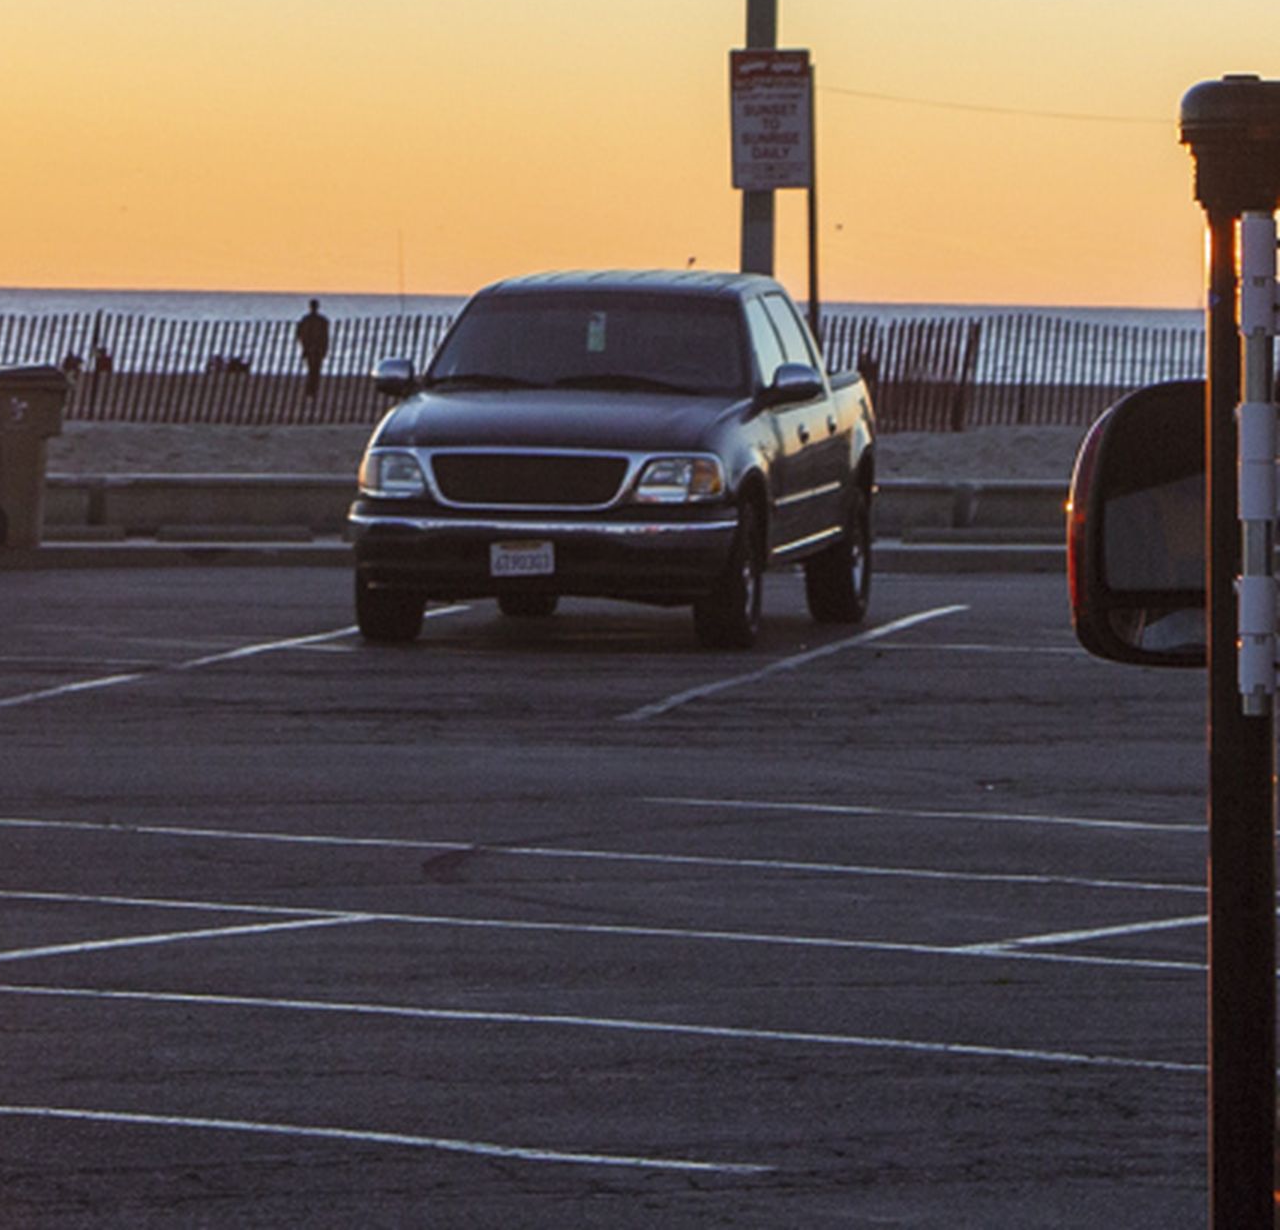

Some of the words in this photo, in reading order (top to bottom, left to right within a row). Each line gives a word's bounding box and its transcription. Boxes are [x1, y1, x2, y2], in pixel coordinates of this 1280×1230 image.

[743, 103, 798, 116] SUNSET
[762, 117, 781, 130] TO
[742, 132, 800, 145] SUNRISE
[751, 146, 791, 159] DAILY
